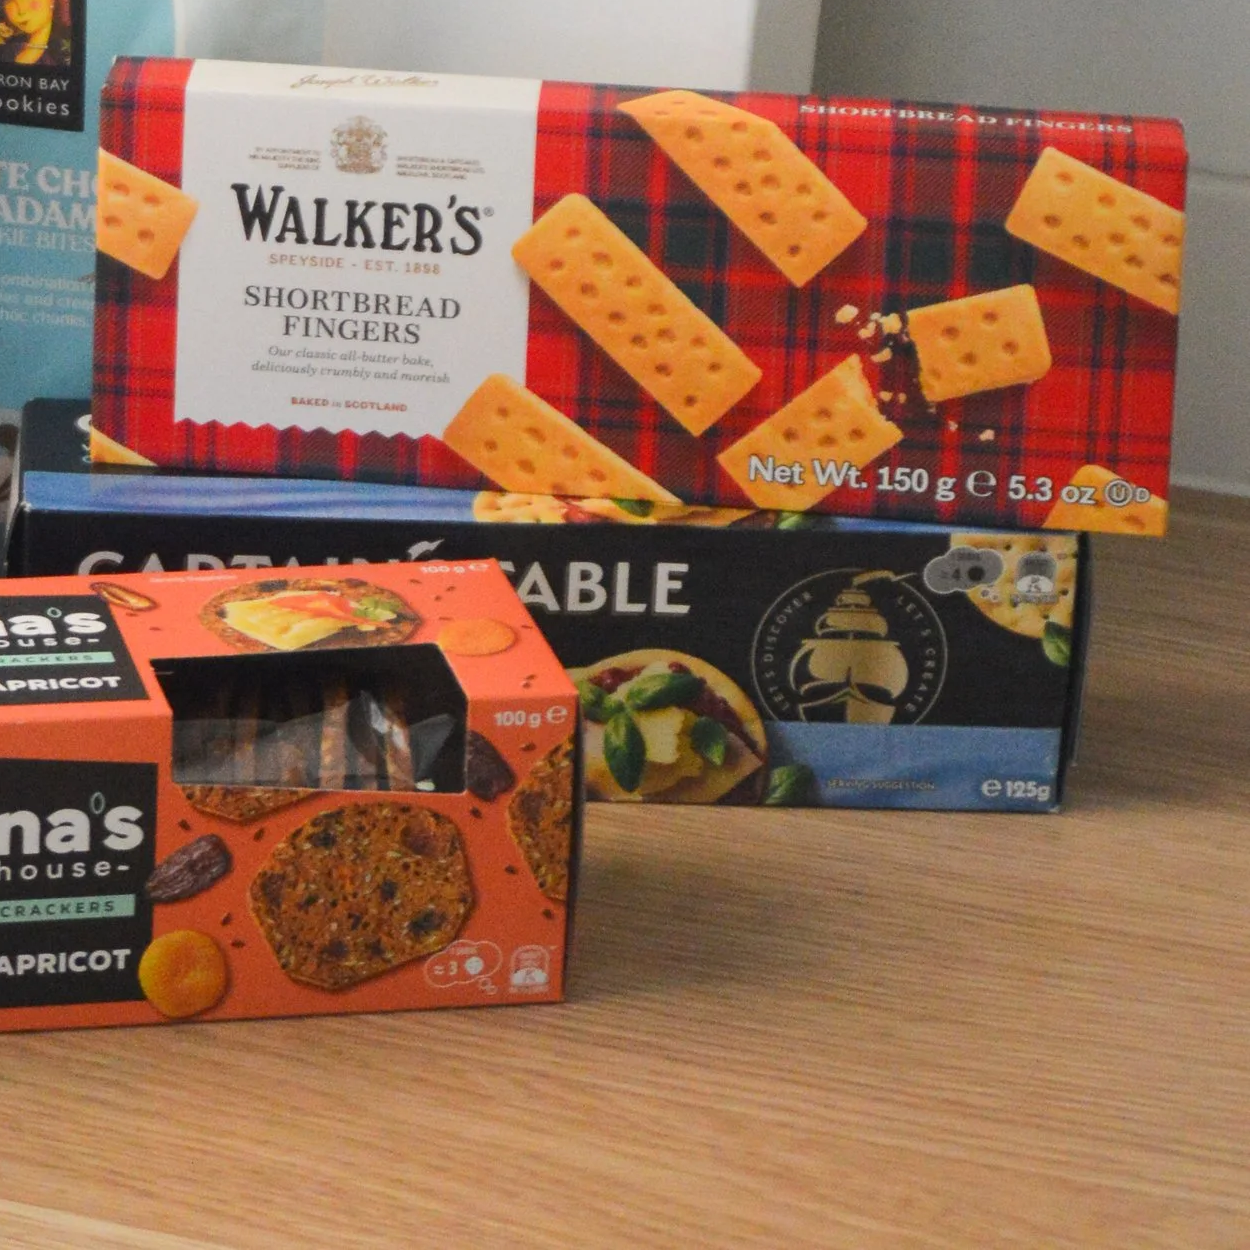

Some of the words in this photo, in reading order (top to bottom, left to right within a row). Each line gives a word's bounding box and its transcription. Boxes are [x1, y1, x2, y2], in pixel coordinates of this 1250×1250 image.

[38, 76, 70, 92] BAY
[799, 103, 998, 125] SHORTBREAD
[1004, 116, 1134, 134] FINGERS
[35, 164, 98, 199] CH
[230, 182, 485, 256] WALKER'S
[268, 253, 345, 269] SPEYSIDE
[364, 258, 399, 273] EST.
[405, 261, 441, 276] 1898
[243, 285, 461, 320] SHORTBREAD
[282, 315, 420, 345] FINGERS
[268, 345, 293, 357] Our
[295, 348, 337, 361] classic
[339, 349, 399, 365] all-butter
[402, 354, 435, 368] bake,
[251, 360, 318, 377] deliciously
[320, 366, 371, 380] crumbly
[373, 368, 399, 381] and
[291, 396, 329, 407] BAKED
[344, 400, 408, 413] SCOTLAND
[749, 454, 804, 485] Net
[812, 458, 868, 490] Wt.
[877, 465, 930, 493] 150
[935, 475, 957, 502] g
[1008, 475, 1053, 502] 5.3
[1060, 484, 1096, 505] oz
[493, 710, 527, 727] 100
[1005, 780, 1052, 802] 125g
[0, 899, 117, 919] CRACKERS
